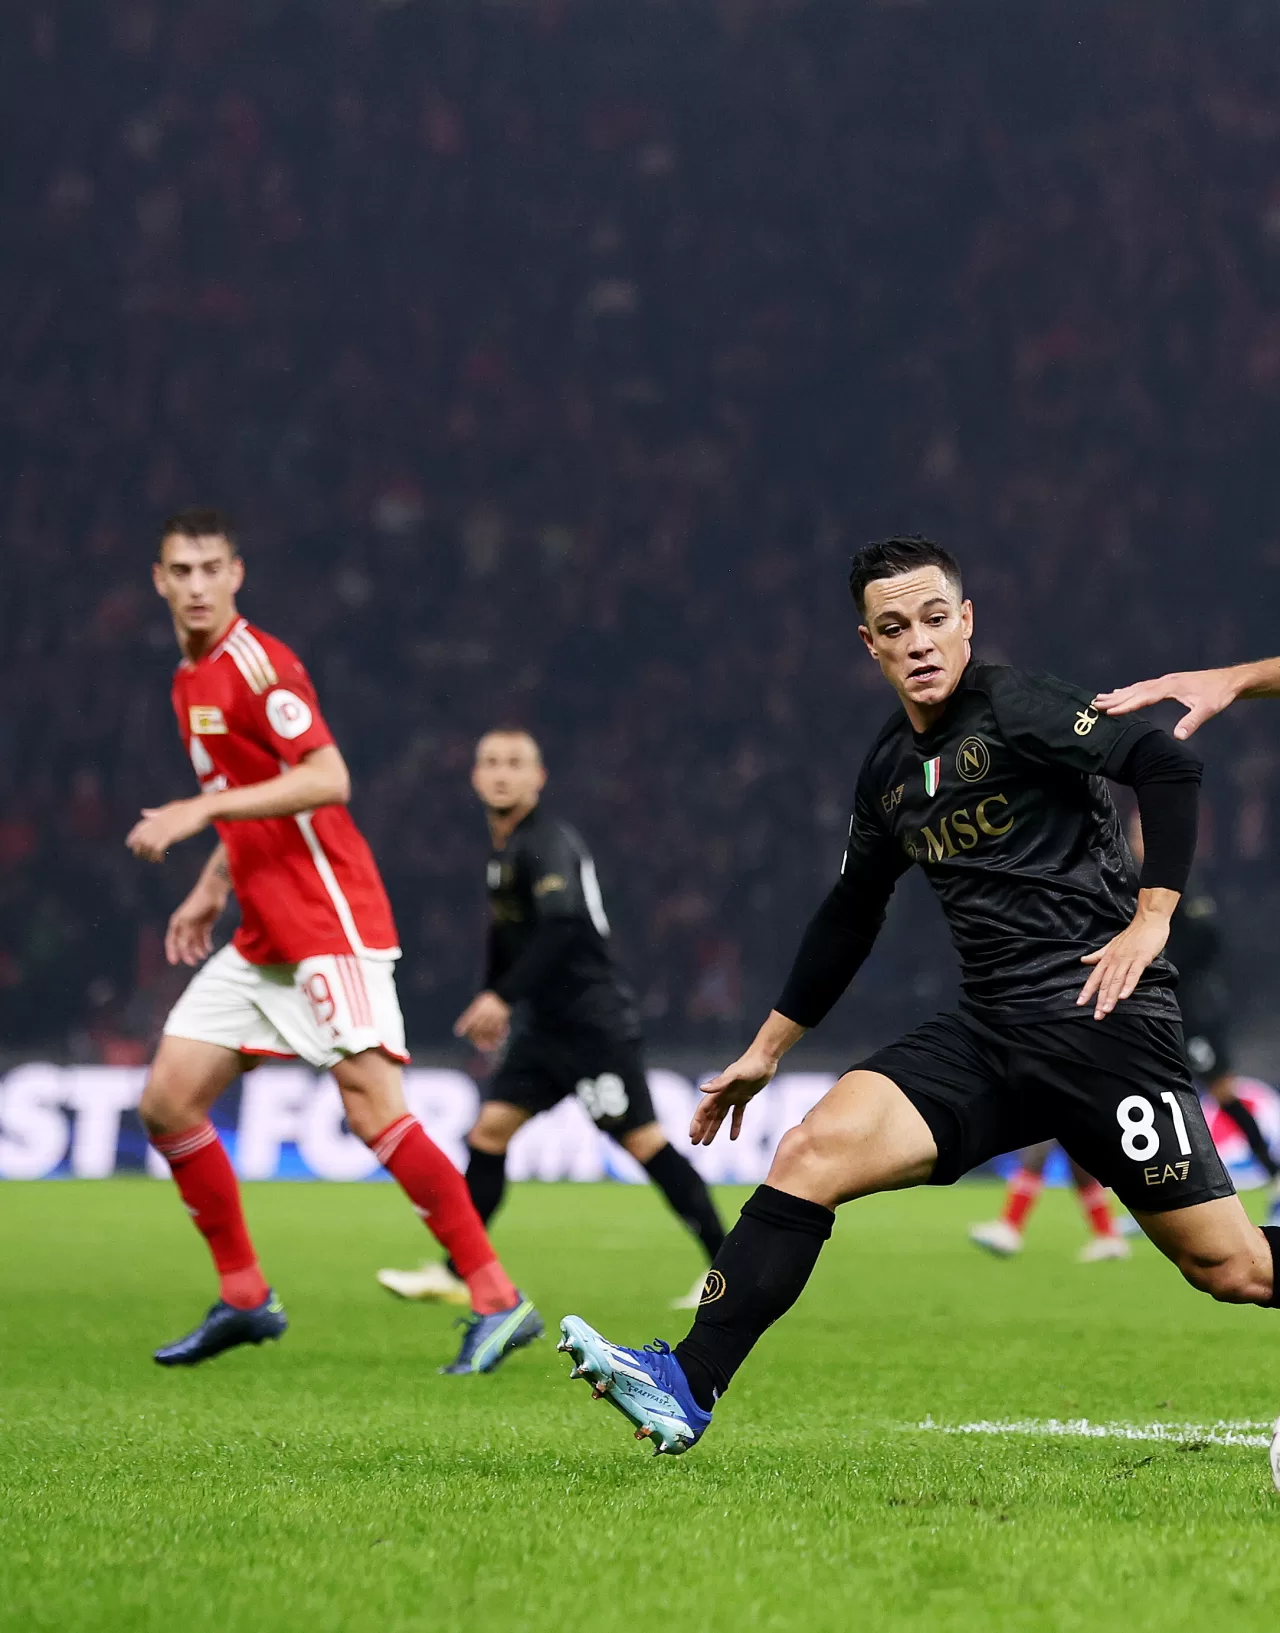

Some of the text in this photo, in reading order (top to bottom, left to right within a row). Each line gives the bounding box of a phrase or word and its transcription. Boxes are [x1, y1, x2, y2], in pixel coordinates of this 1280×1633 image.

[1074, 698, 1099, 736] eb
[881, 783, 905, 813] EA7
[920, 793, 1015, 864] MSC
[1116, 1091, 1192, 1162] 81
[1143, 1161, 1190, 1186] EA7
